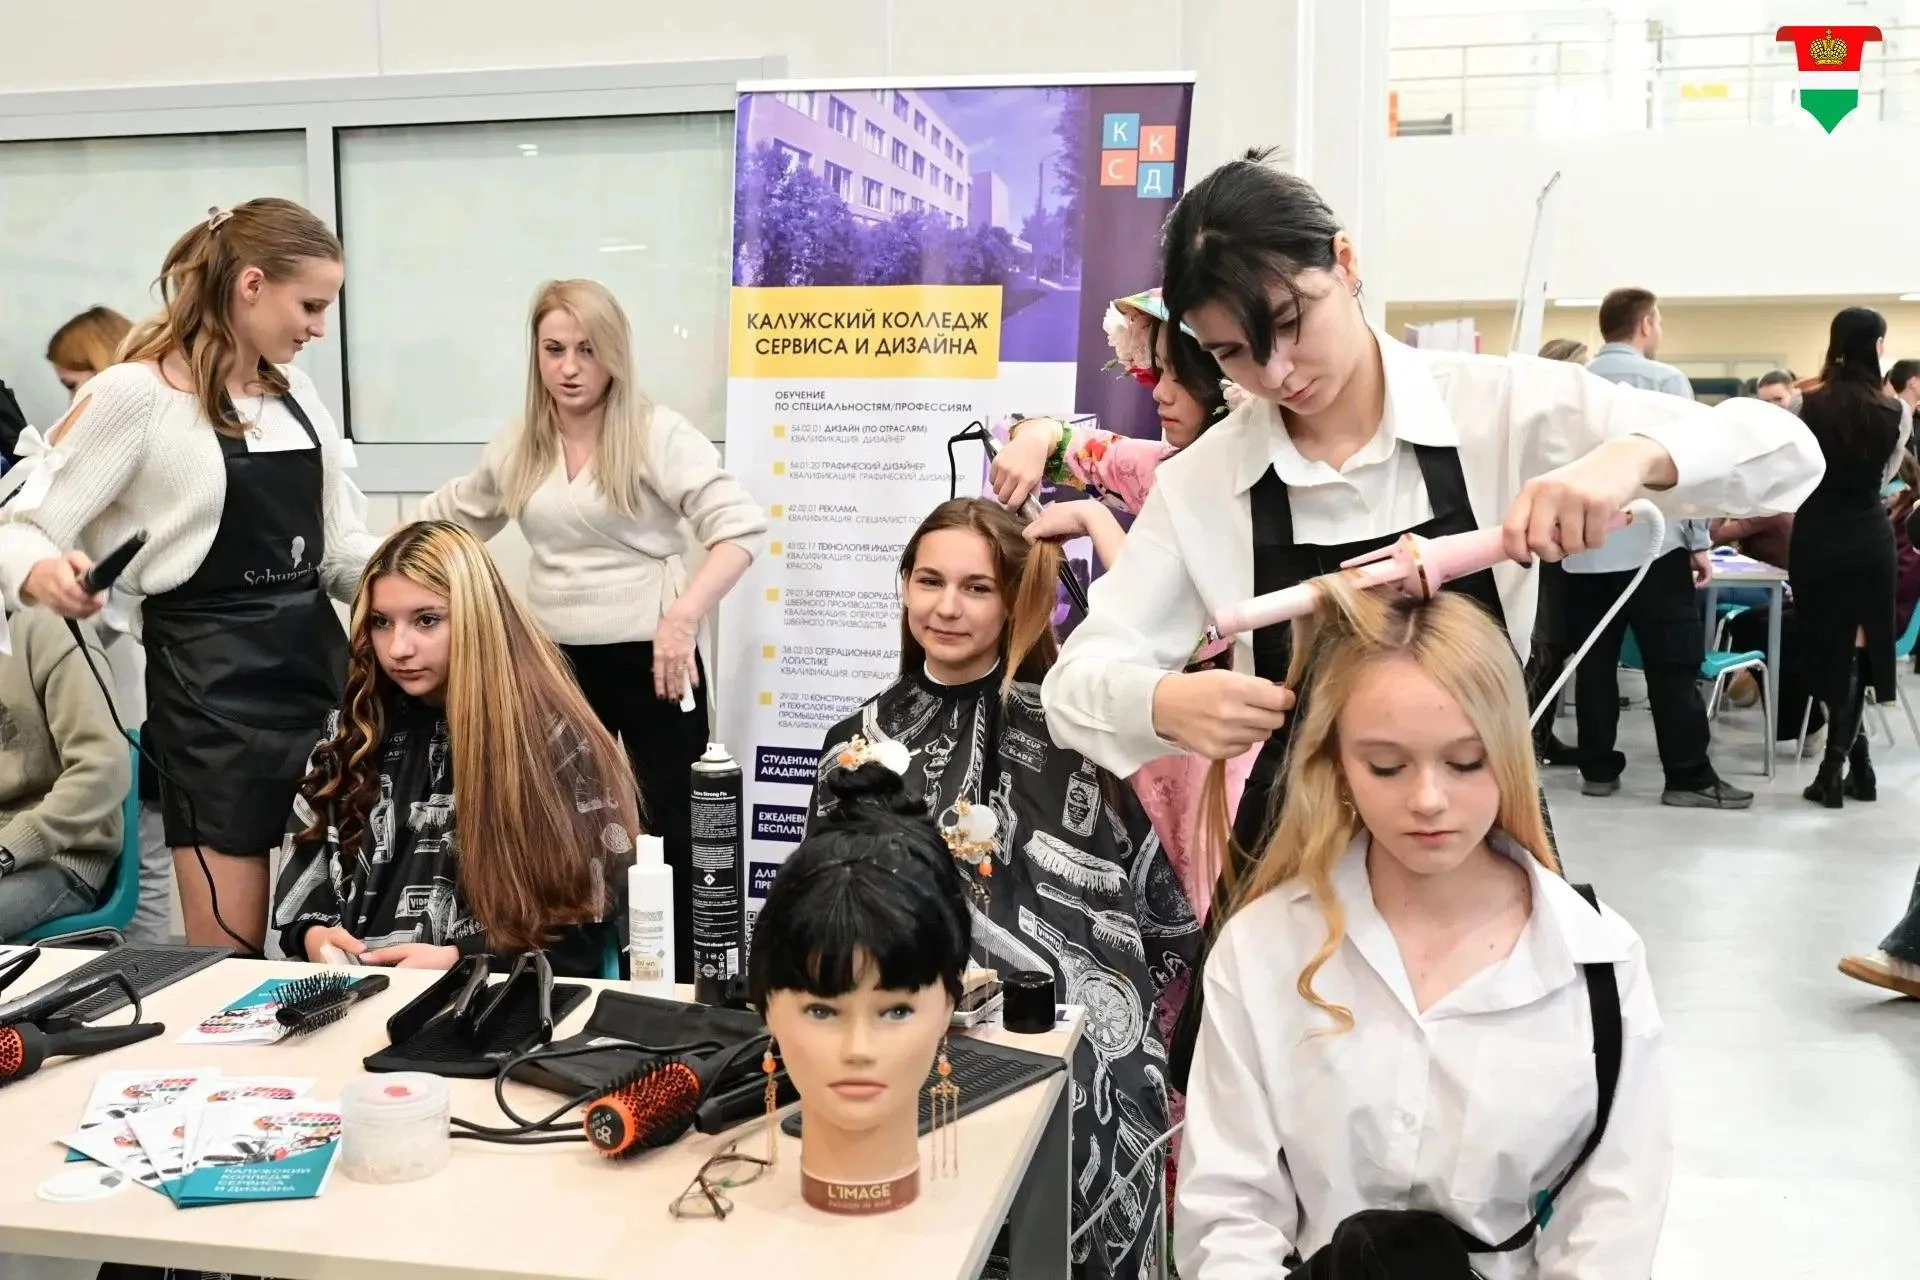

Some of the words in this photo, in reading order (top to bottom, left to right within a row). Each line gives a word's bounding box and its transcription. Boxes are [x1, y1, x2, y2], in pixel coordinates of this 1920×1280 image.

[1112, 121, 1128, 142] К
[1148, 133, 1164, 156] К
[1107, 158, 1125, 180] С
[1143, 169, 1161, 194] Д
[747, 308, 875, 329] КАЛУЖСКИЙ
[882, 311, 988, 331] КОЛЛЕДЖ
[755, 338, 848, 355] СЕРВИСА
[855, 338, 869, 354] И
[875, 333, 978, 357] ДИЗАЙНА
[775, 391, 825, 399] ОБУЧЕНИЕ
[775, 402, 790, 411] ПО
[792, 402, 972, 412] СПЕЦИАЛЬНОСТЯМ/ПРОФЕССИЯМ
[824, 424, 860, 433] ДИЗАЙН
[879, 425, 928, 434] ОТРАСЛЯМ)
[819, 504, 858, 513] РЕКЛАМА
[818, 542, 870, 551] ТЕХНОЛОГИЯ
[814, 589, 856, 598] ОПЕРАТОР
[815, 647, 881, 657] ОПЕРАЦИОННАЯ
[781, 656, 829, 666] ЛОГИСТИКЕ
[787, 703, 835, 711] ТЕХНОЛОГИЯ
[761, 754, 818, 766] СТУДЕНТАМ
[754, 868, 777, 878] ДЛЯ
[827, 1183, 892, 1200] L'IMAGE
